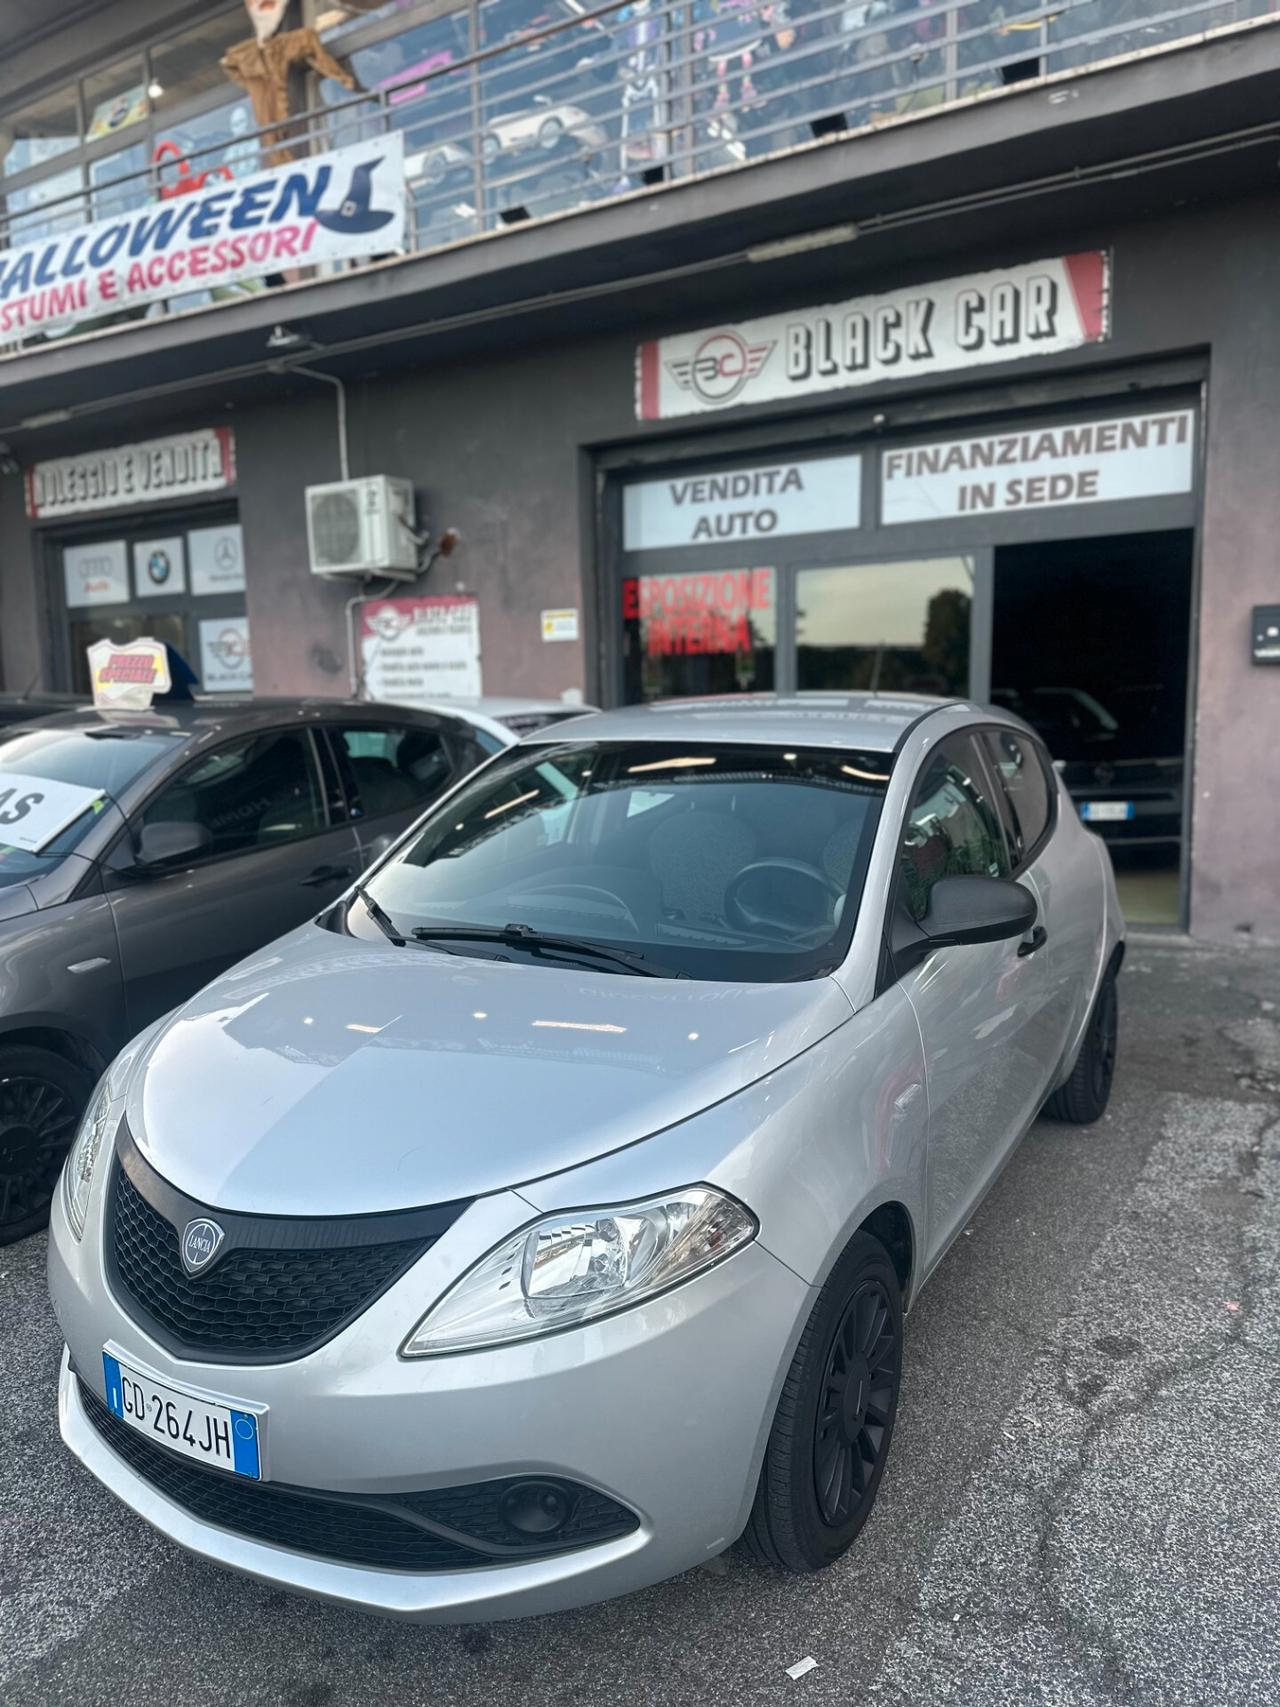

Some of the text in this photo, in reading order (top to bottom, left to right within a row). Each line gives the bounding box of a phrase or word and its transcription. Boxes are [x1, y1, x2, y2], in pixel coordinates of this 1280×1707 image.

[98, 269, 119, 301] E
[126, 219, 320, 294] ACCESSORI
[785, 273, 1059, 383] BLACK CAR
[885, 414, 1190, 480] FINANZIAMENTI
[669, 466, 804, 507] VENDITA
[957, 469, 1100, 512] IN SEDE
[691, 508, 779, 541] AUTO
[622, 569, 771, 620] ESPOSIZIONE
[647, 612, 751, 656] INTERNA
[188, 1234, 211, 1254] LANCIA
